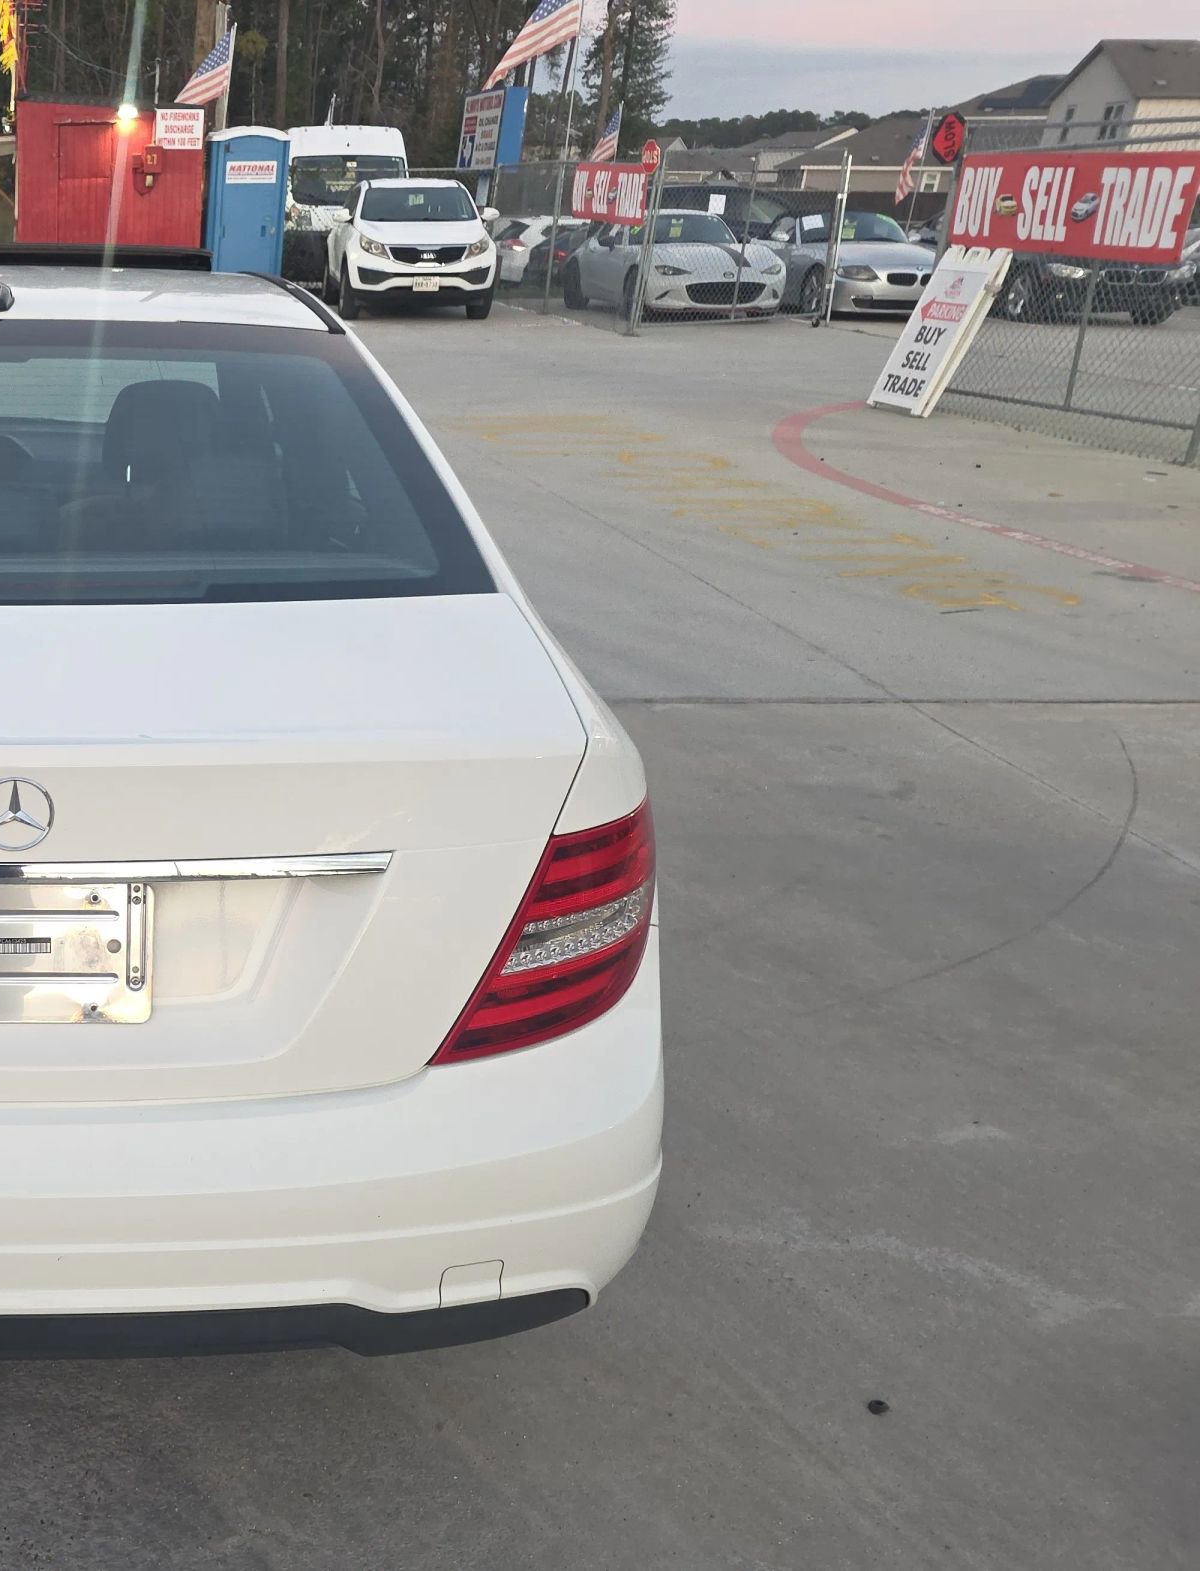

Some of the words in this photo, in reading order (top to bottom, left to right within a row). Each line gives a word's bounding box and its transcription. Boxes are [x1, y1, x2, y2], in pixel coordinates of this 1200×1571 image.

[160, 112, 168, 121] NO
[169, 112, 200, 121] FIREWORKS
[164, 125, 194, 134] DISCHARGE
[943, 119, 956, 160] SLOW
[187, 137, 200, 146] FEET
[229, 164, 274, 172] NATIONAL
[572, 170, 589, 213] BUY
[592, 170, 612, 214] SELL
[615, 172, 646, 218] TRADE
[952, 167, 1003, 237] BUY
[1016, 165, 1075, 242] SELL
[1092, 166, 1195, 249] TRADE
[926, 302, 966, 321] PARKING
[914, 325, 947, 346] BUY
[901, 350, 931, 371] SELL
[882, 373, 926, 398] TRADE
